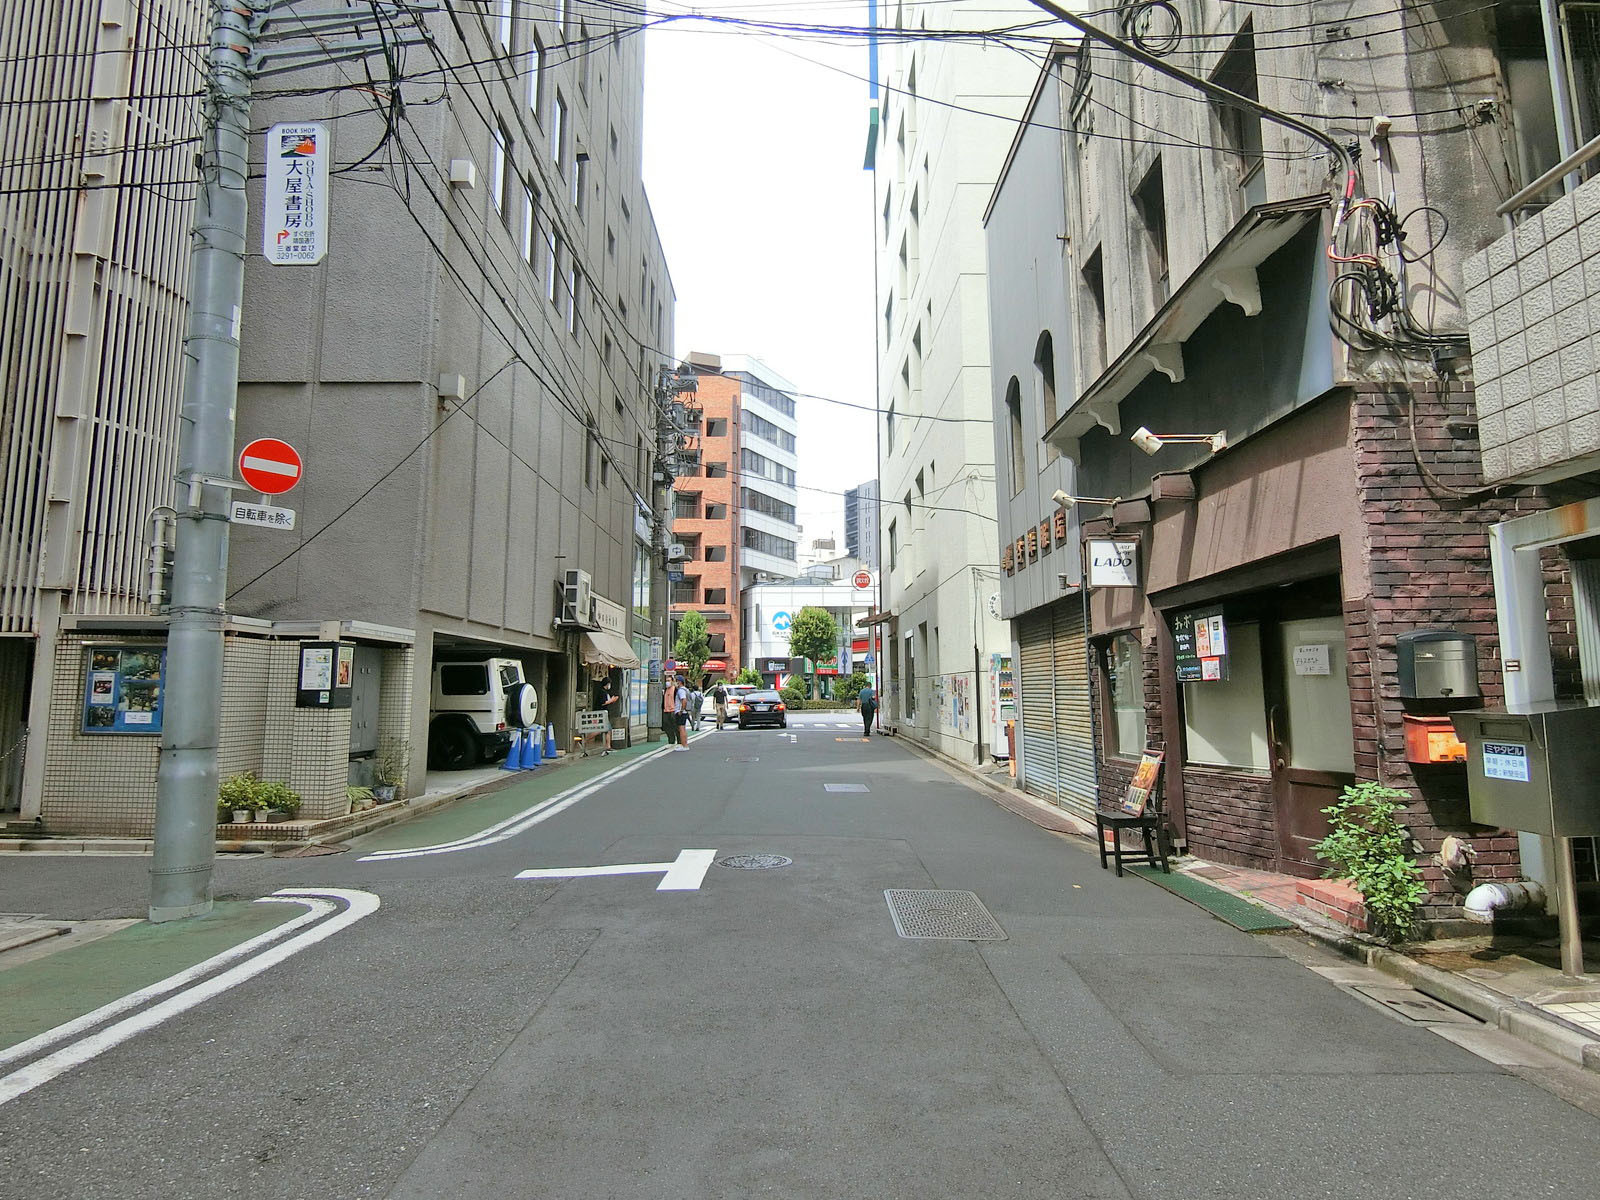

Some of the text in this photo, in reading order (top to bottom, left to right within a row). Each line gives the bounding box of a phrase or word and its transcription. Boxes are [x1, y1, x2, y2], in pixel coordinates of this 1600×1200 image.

[285, 160, 302, 228] 大屋書房
[235, 508, 291, 525] 自転車を除く
[1094, 558, 1132, 567] LADO
[1486, 745, 1522, 755] ミヤタビル
